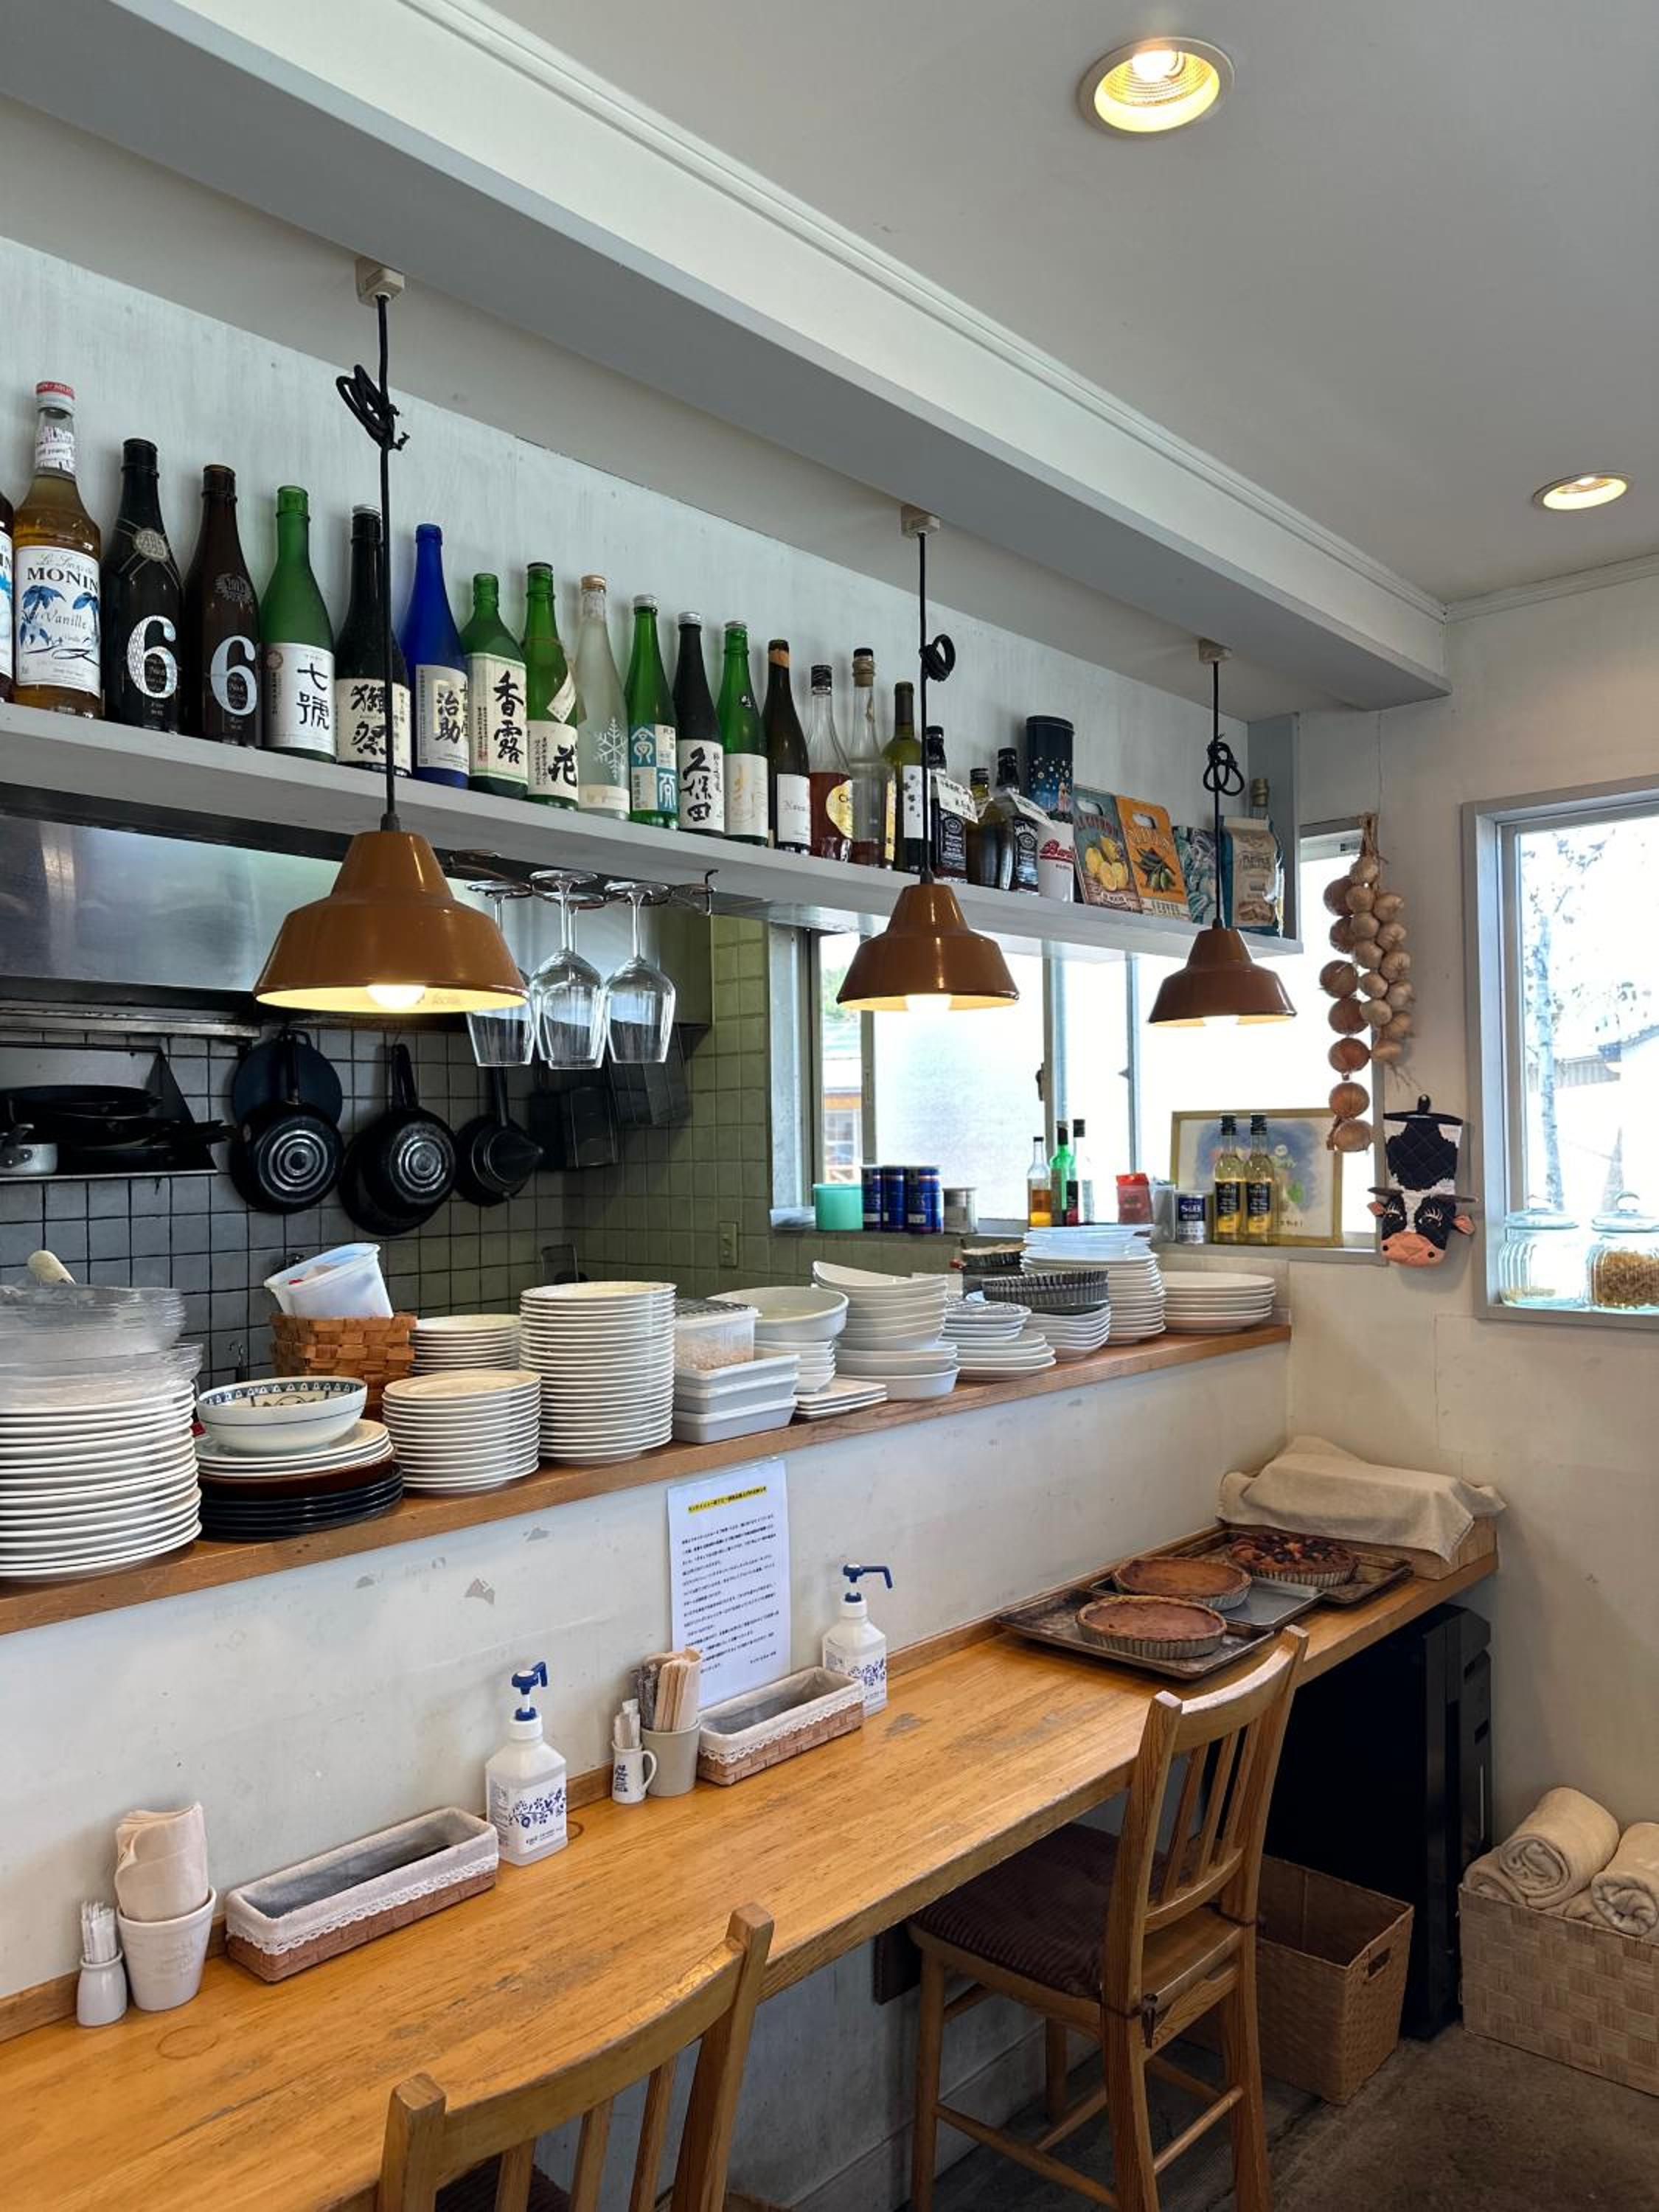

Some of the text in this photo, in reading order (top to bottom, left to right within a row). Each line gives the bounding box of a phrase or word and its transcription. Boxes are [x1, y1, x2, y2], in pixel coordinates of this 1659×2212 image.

[27, 567, 100, 593] MONIN
[127, 615, 178, 699] 6
[211, 636, 257, 716] 6
[493, 670, 524, 765] 香露
[679, 747, 712, 822] 久保田
[1180, 1204, 1203, 1213] S&B
